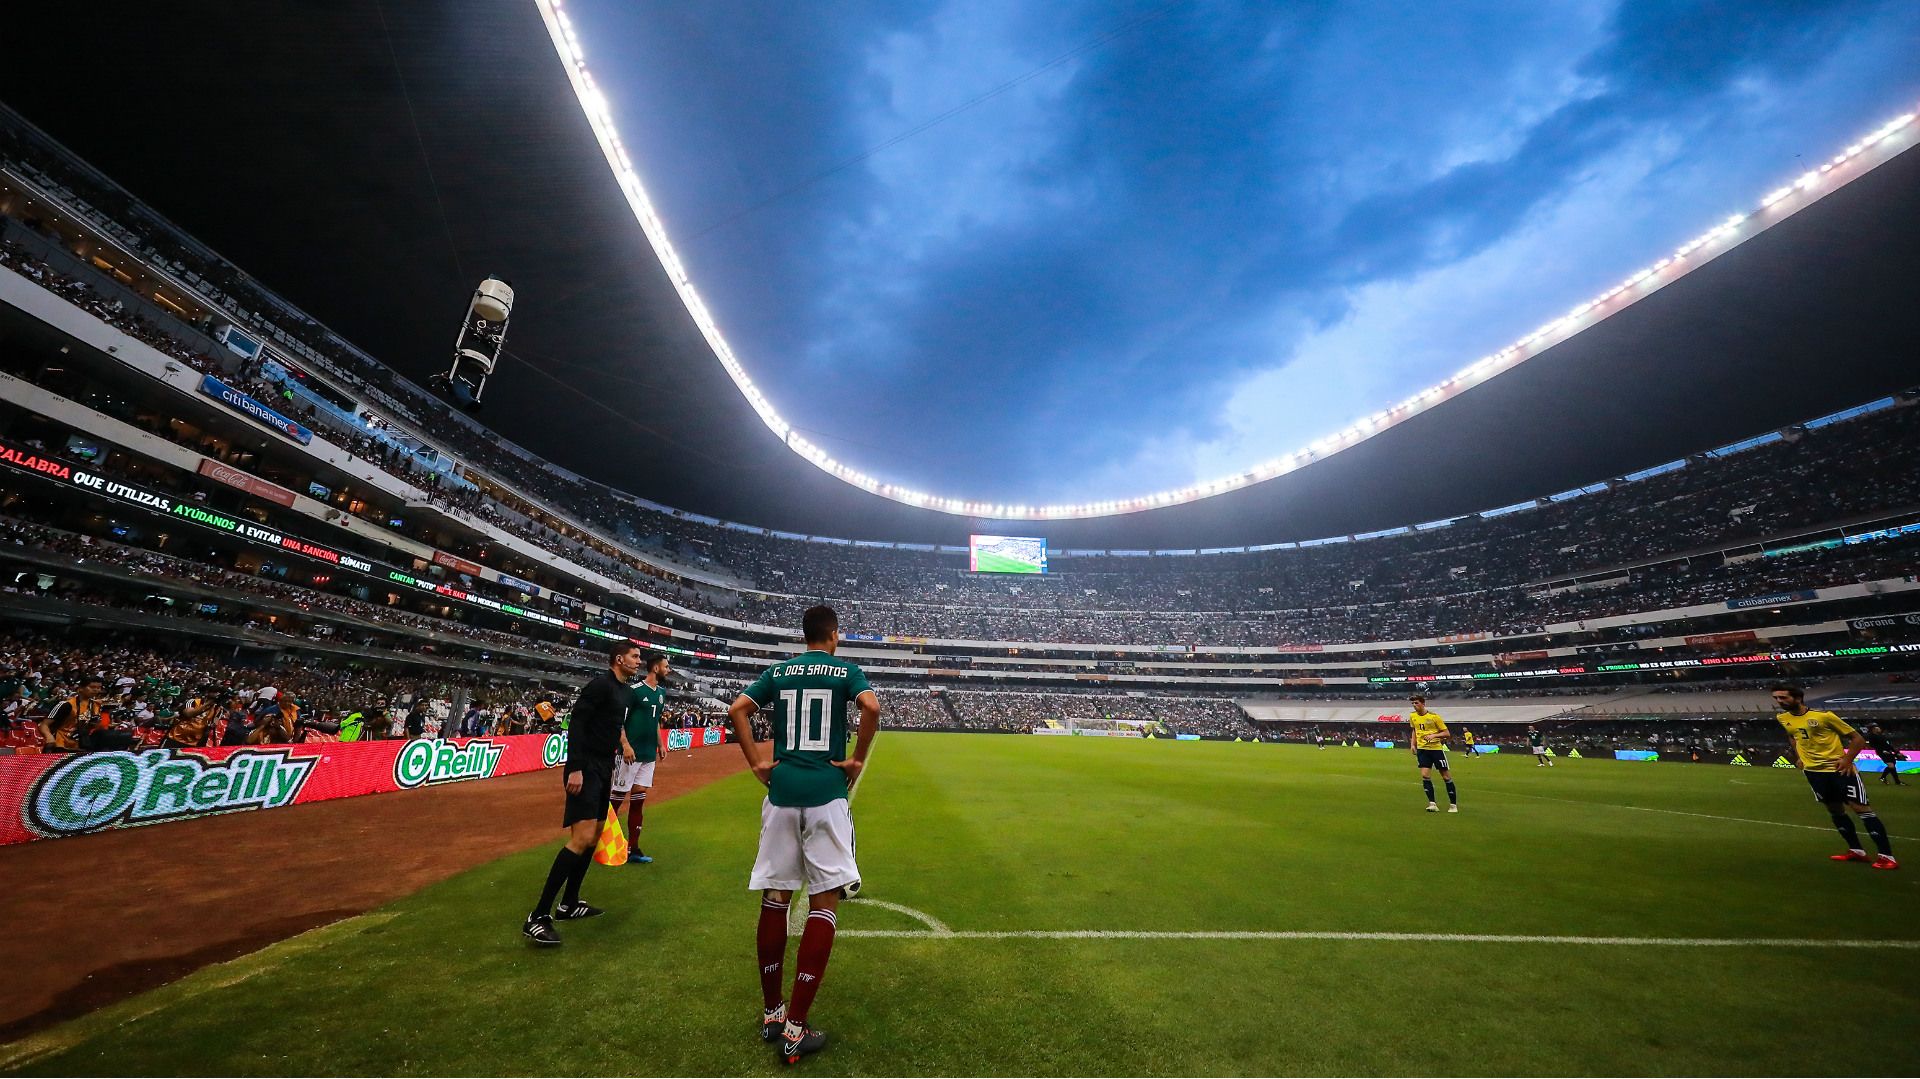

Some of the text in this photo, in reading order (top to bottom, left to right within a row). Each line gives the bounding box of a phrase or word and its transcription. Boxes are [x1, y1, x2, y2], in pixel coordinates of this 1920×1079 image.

[222, 390, 289, 432] citibanamex
[73, 471, 105, 489] QUE
[106, 481, 171, 513] UTILIZAS,
[173, 504, 236, 530] AYÚDANOS
[236, 524, 244, 534] A
[246, 527, 282, 545] EVITAR
[282, 538, 301, 550] UNA
[302, 545, 339, 563] SANCIÓN,
[389, 571, 415, 585] CANTAR
[1738, 594, 1792, 607] citibanamex
[1853, 617, 1896, 630] Corona
[1673, 659, 1702, 667] GRITES,
[1789, 650, 1834, 659] UTILIZAS,
[1835, 646, 1888, 655] AYÚDANOS
[772, 664, 848, 678] G. DOS SANTOS
[651, 704, 657, 718] 7
[780, 688, 832, 751] 10
[668, 729, 692, 749] O'Reilly
[1798, 728, 1809, 740] 3
[401, 740, 498, 781] O'Reilly
[1439, 759, 1447, 768] 11
[49, 752, 300, 824] O'Reilly
[1847, 785, 1857, 798] 3
